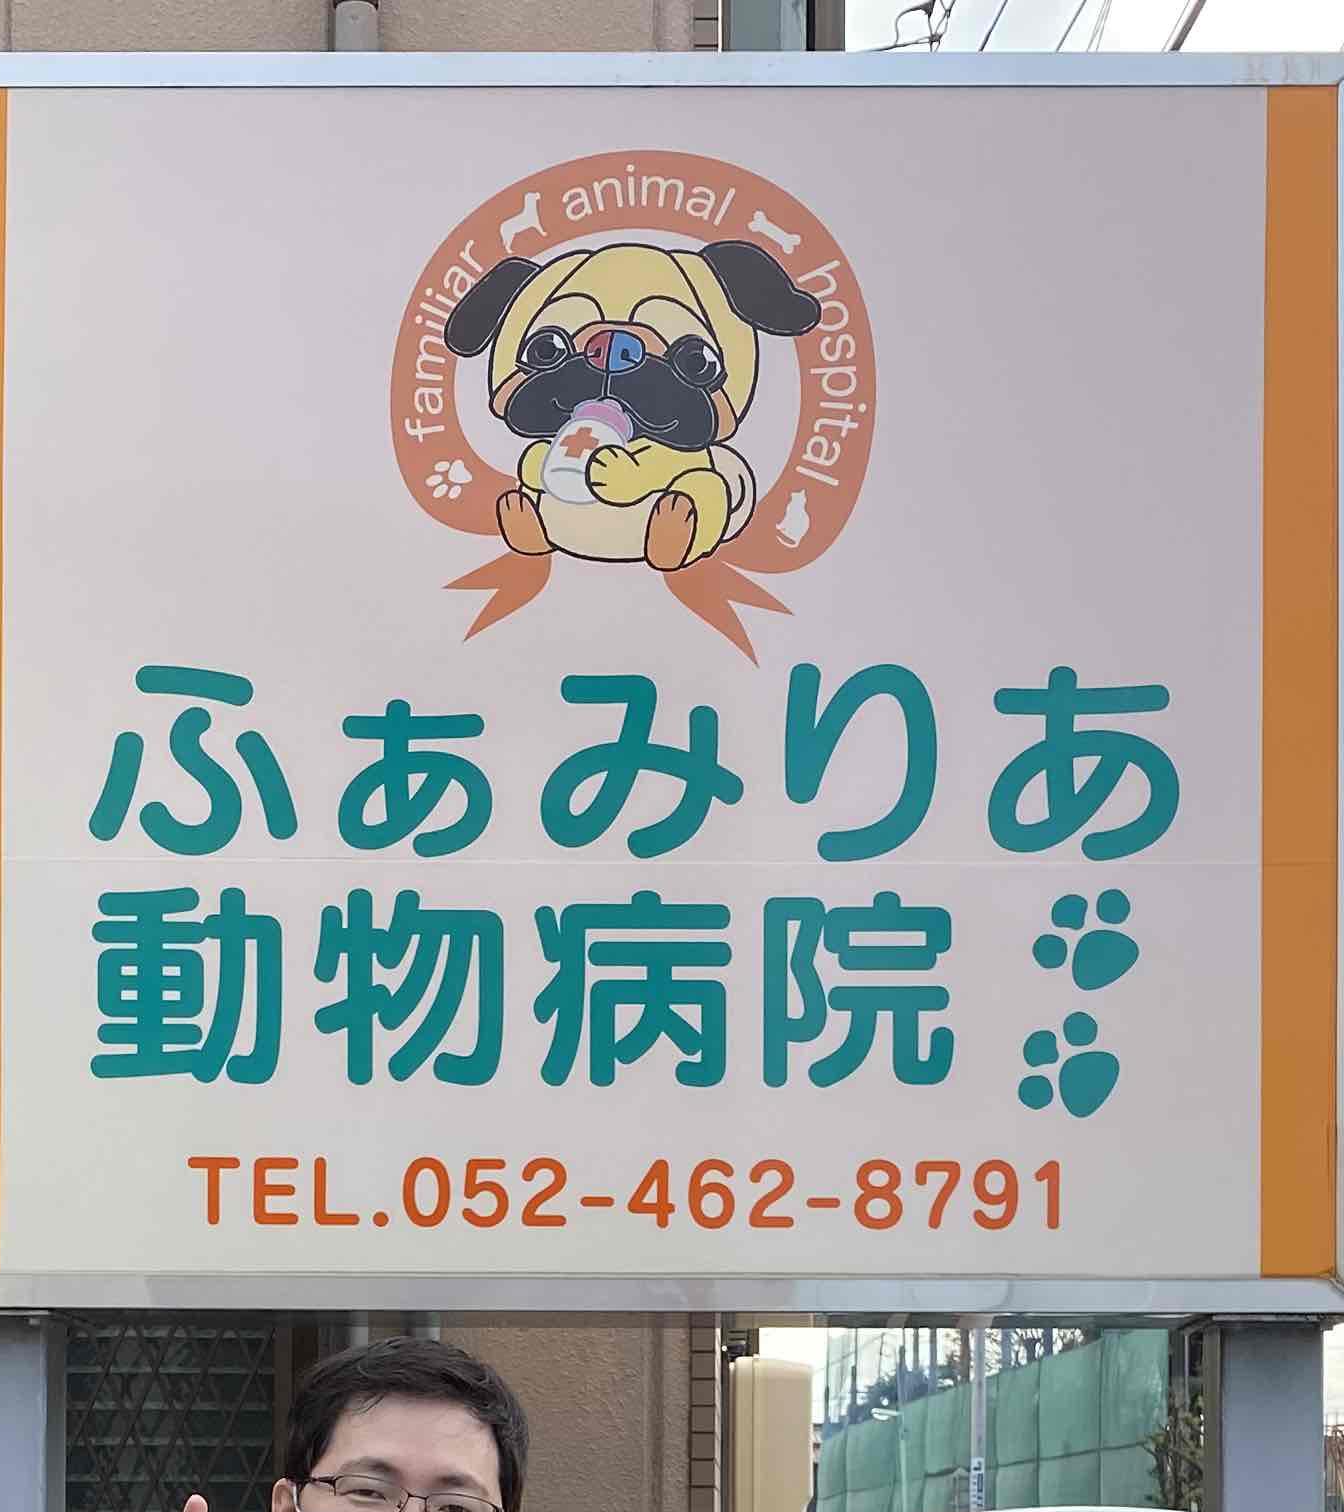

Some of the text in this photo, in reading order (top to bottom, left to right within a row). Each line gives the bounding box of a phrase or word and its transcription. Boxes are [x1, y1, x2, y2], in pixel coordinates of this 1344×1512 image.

[405, 164, 869, 488] familiar animal hospital
[89, 663, 1180, 862] ふぁみりあ
[90, 887, 955, 1088] 動物病院
